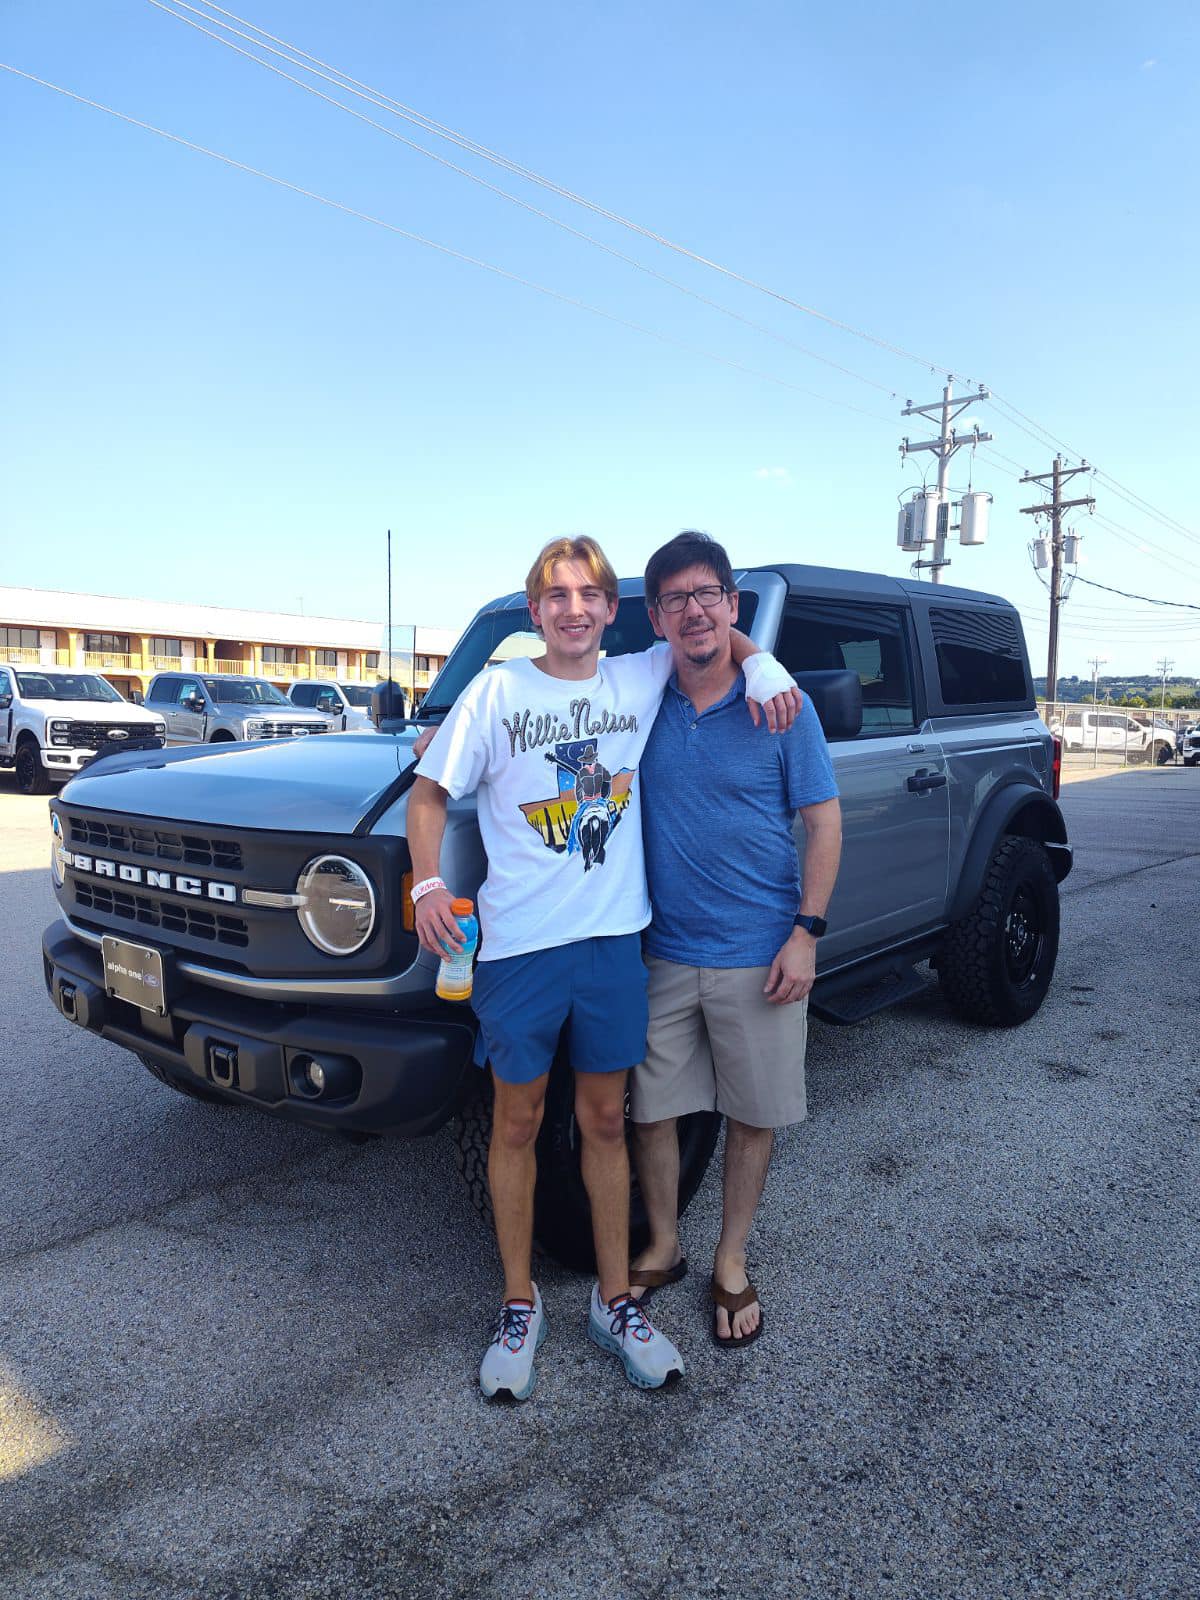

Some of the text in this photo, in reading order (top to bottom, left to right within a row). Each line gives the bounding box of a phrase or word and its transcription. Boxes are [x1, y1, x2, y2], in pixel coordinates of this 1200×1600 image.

[502, 697, 639, 758] Willie Nelson
[74, 854, 237, 903] BRONCO
[107, 961, 128, 976] alpha
[127, 969, 143, 981] one
